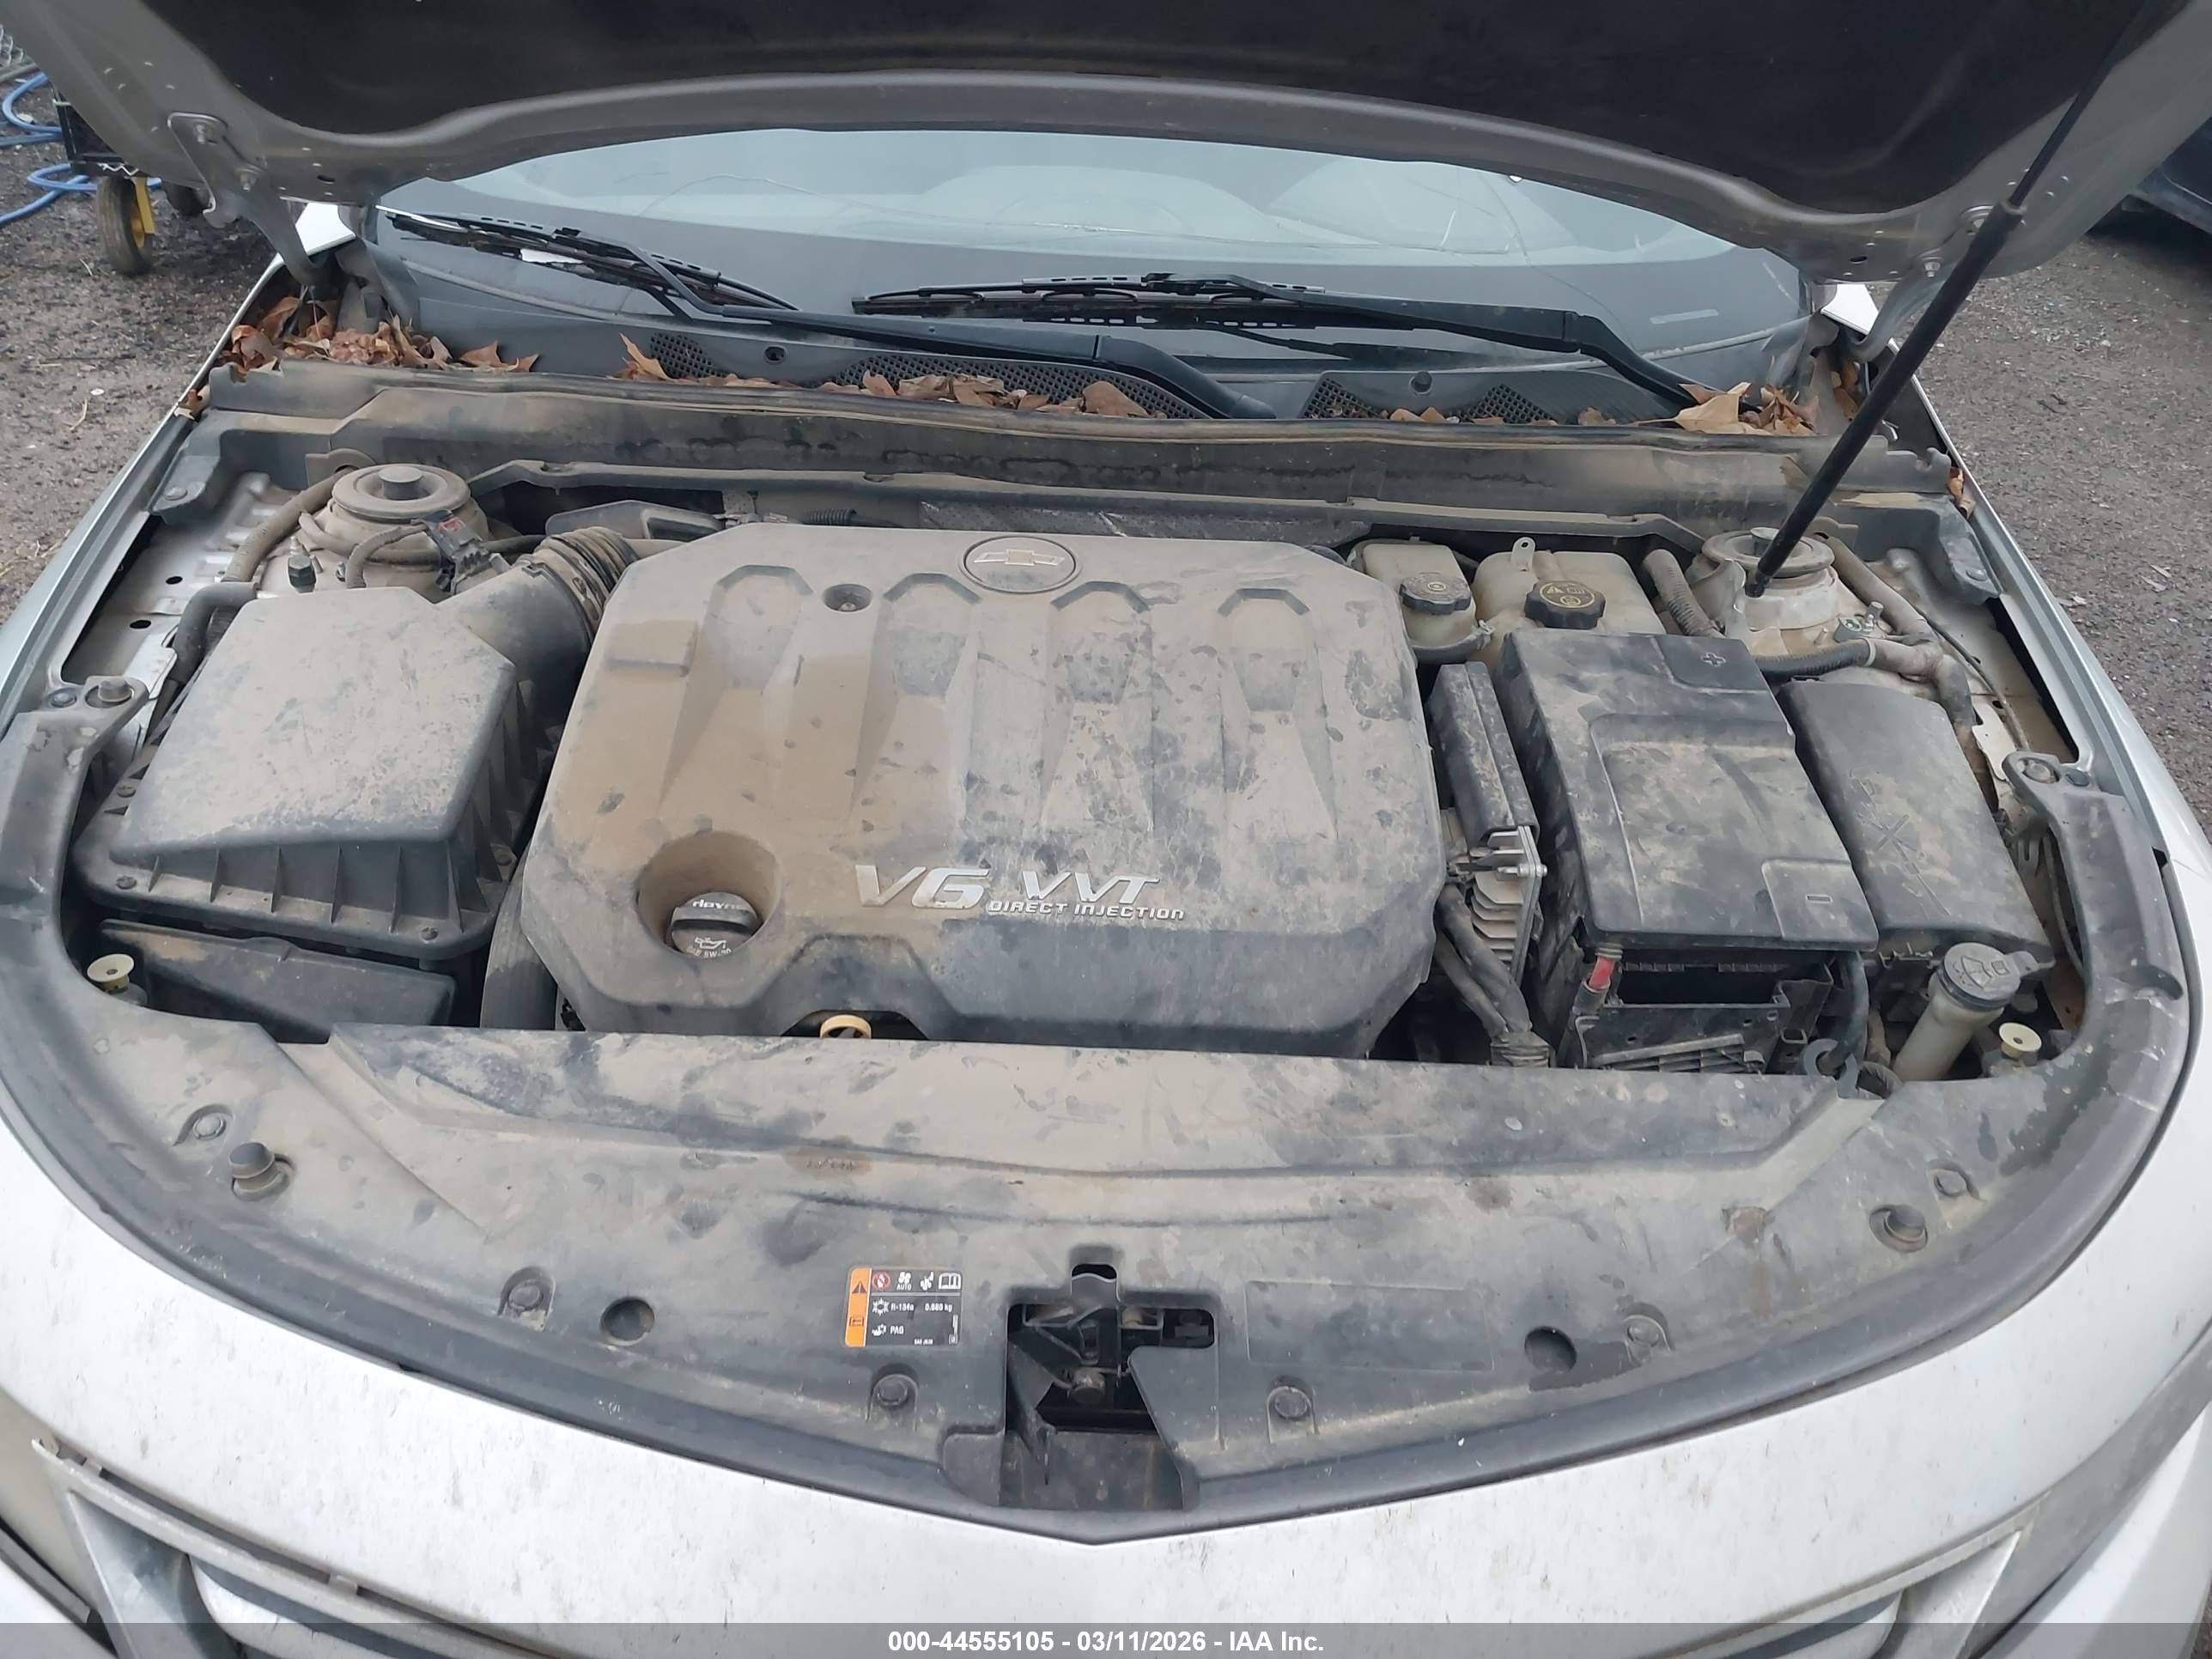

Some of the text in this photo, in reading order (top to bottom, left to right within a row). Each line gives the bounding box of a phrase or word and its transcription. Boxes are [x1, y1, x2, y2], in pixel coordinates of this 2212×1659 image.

[855, 865, 1161, 909] V6 VVT
[988, 900, 1186, 921] DIRECT INJECTION
[945, 1303, 953, 1313] kg
